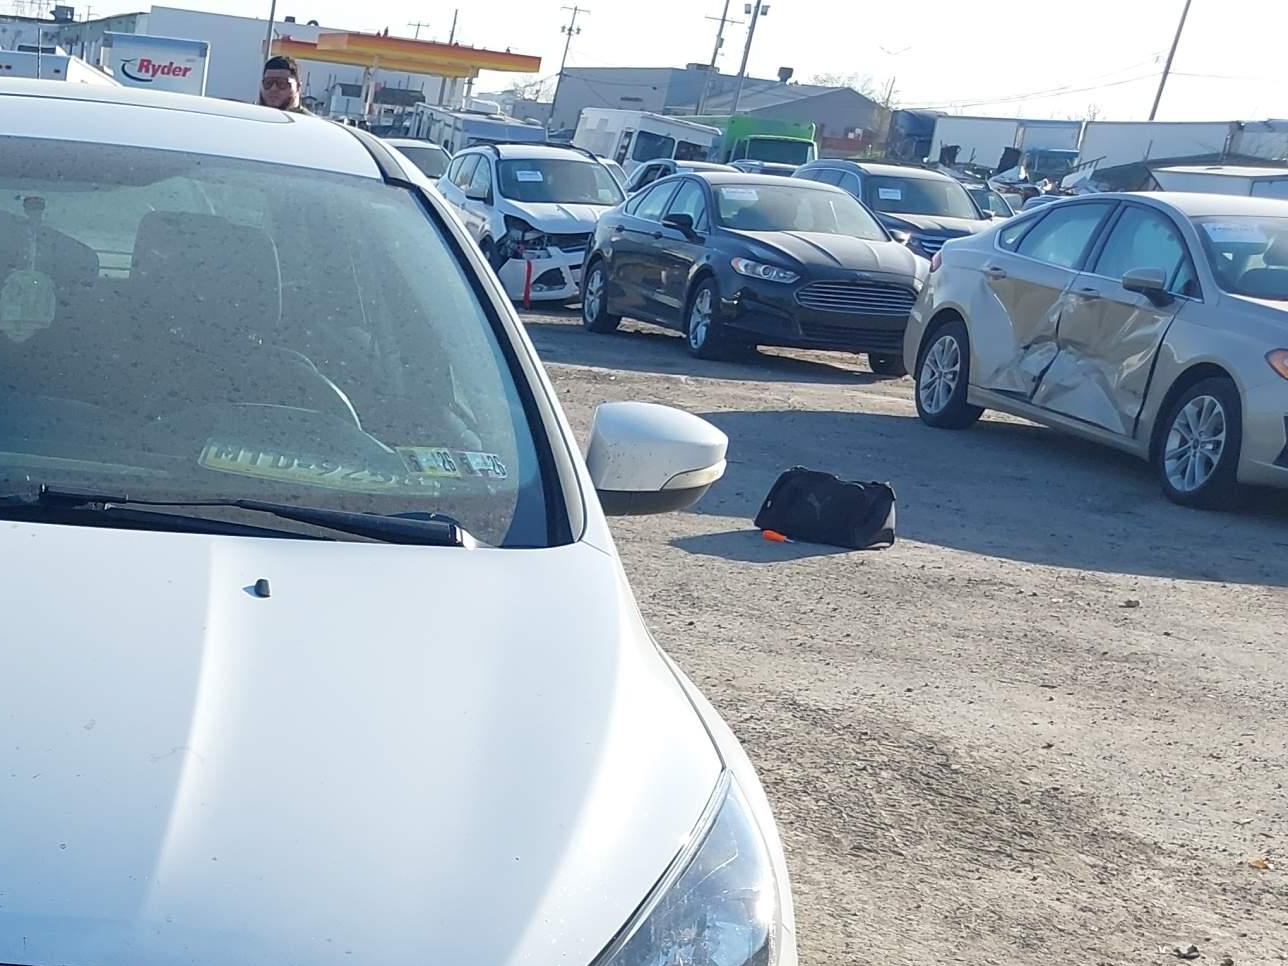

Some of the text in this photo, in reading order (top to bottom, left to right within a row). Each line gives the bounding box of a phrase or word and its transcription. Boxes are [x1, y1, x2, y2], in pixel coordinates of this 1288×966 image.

[137, 58, 192, 77] Ryder
[436, 451, 457, 473] 26
[486, 454, 507, 476] 26
